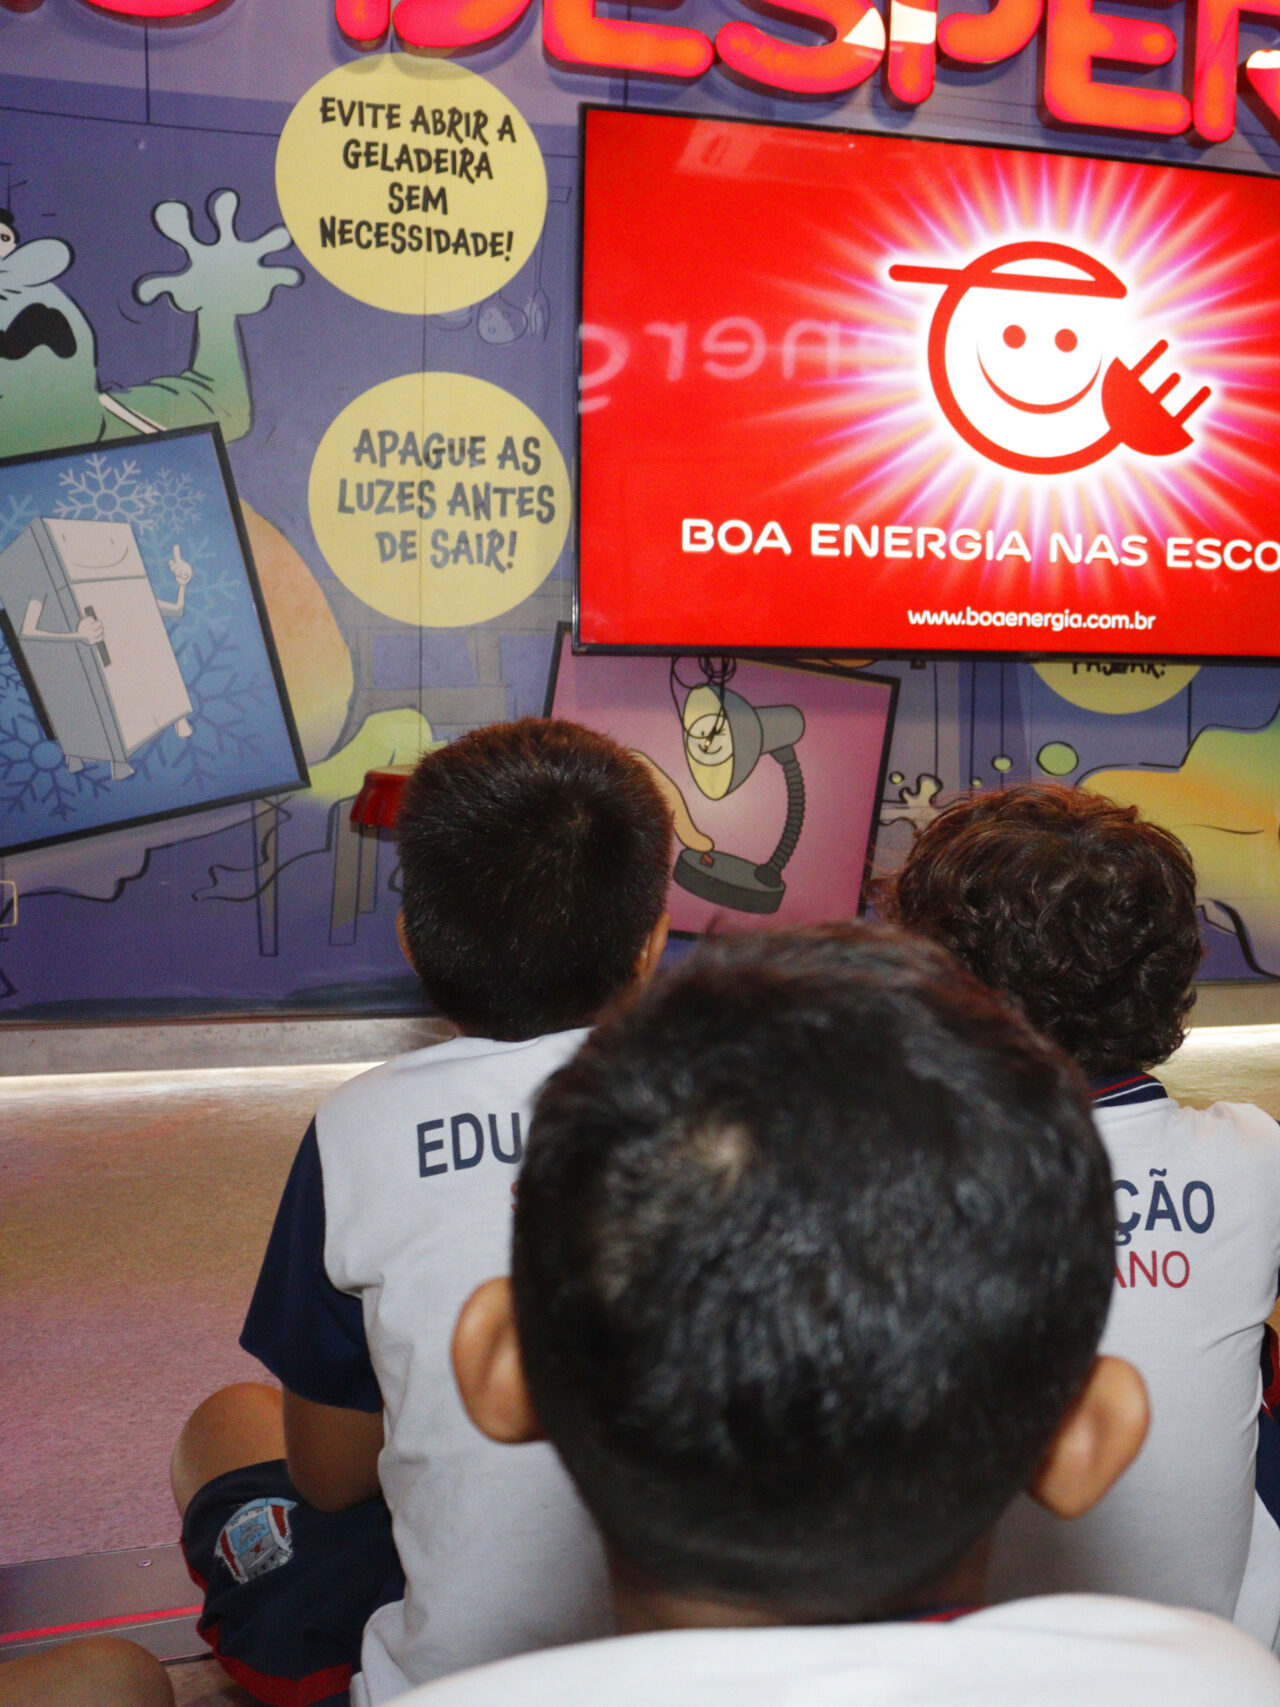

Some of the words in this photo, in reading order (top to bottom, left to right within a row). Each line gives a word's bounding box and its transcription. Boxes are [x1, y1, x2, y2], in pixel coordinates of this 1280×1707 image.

[320, 96, 401, 130] EVITE
[410, 105, 488, 146] ABRIR
[497, 114, 516, 143] A
[343, 138, 493, 184] GELADEIRA
[388, 182, 448, 215] SEM
[320, 215, 514, 262] NECESSIDADE!
[353, 428, 486, 470] APAGUE
[497, 436, 542, 476] AS
[338, 478, 437, 520] LUZES
[447, 482, 556, 524] ANTES
[375, 530, 417, 563] DE
[430, 528, 517, 574] SAIR!
[682, 519, 791, 556] BOA
[811, 522, 1032, 562] ENERGIA
[1050, 532, 1148, 566] NAS
[907, 606, 1156, 631] www.boaenergia.com.br
